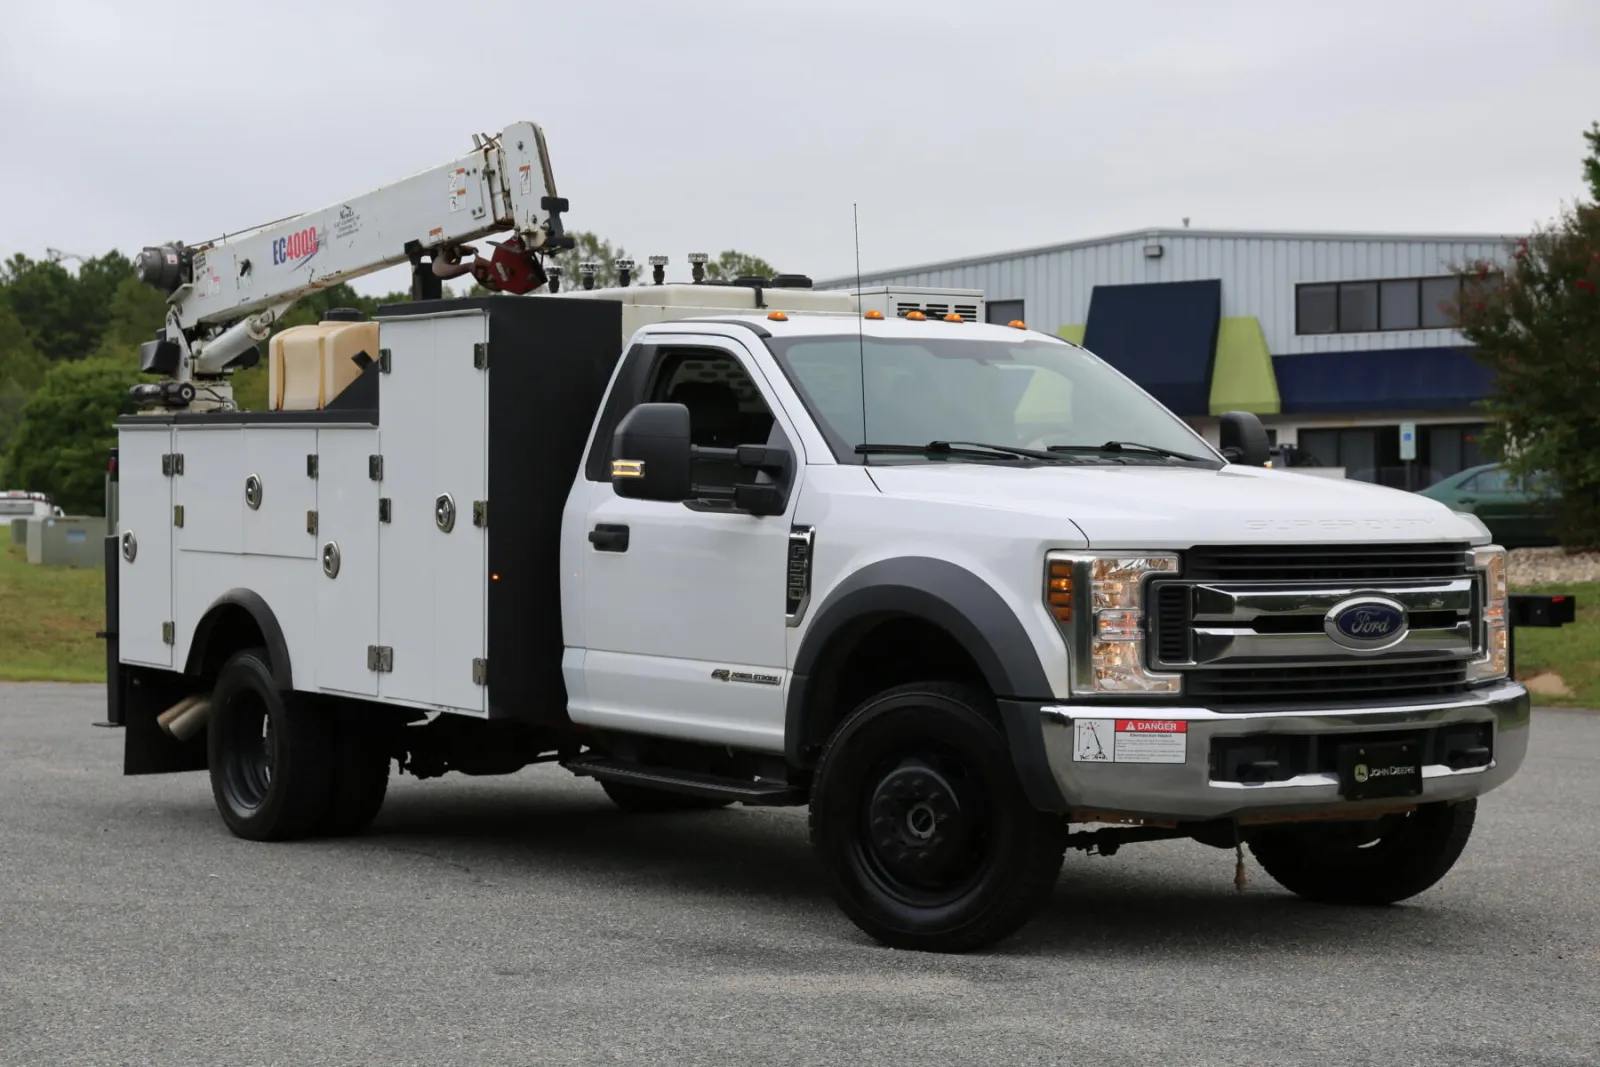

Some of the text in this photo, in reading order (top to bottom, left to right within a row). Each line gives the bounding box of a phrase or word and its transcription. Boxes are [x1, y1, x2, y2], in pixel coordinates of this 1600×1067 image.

[272, 226, 318, 265] EC4000
[1246, 519, 1359, 530] SUPER
[1351, 610, 1391, 633] Ford
[1137, 722, 1177, 731] DANGER
[1369, 766, 1415, 776] JOHN DEERE
